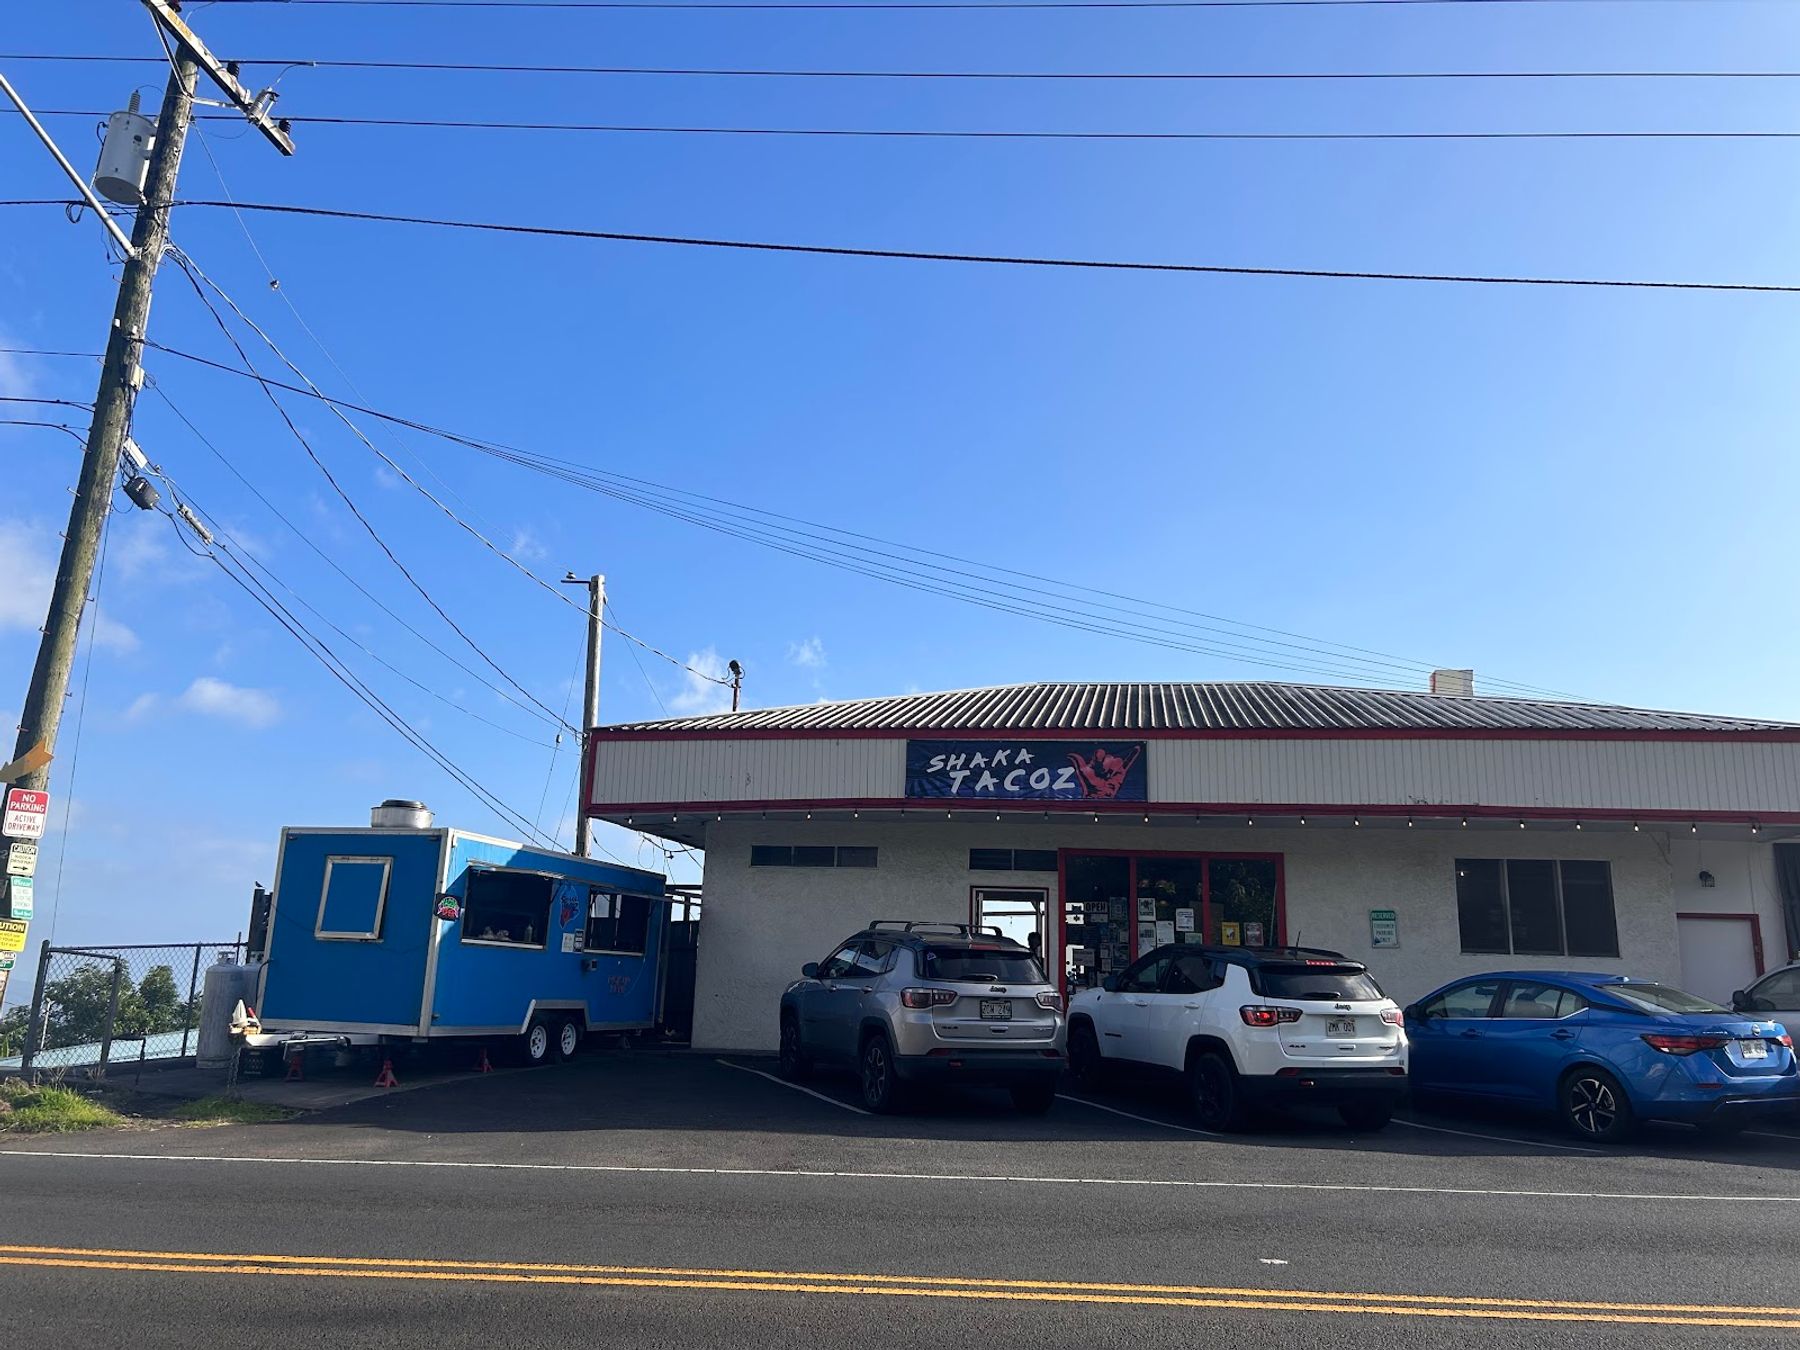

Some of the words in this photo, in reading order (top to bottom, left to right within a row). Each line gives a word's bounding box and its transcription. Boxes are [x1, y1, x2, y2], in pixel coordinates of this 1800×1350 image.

[926, 748, 1035, 773] SHAKA
[949, 767, 1076, 794] TACOZ
[22, 793, 36, 803] NO
[10, 801, 45, 812] PARKING
[15, 814, 36, 824] ACTIVE
[8, 822, 40, 832] DRIVEWAY
[13, 845, 36, 855] CAUTION
[1086, 902, 1106, 912] OPEN
